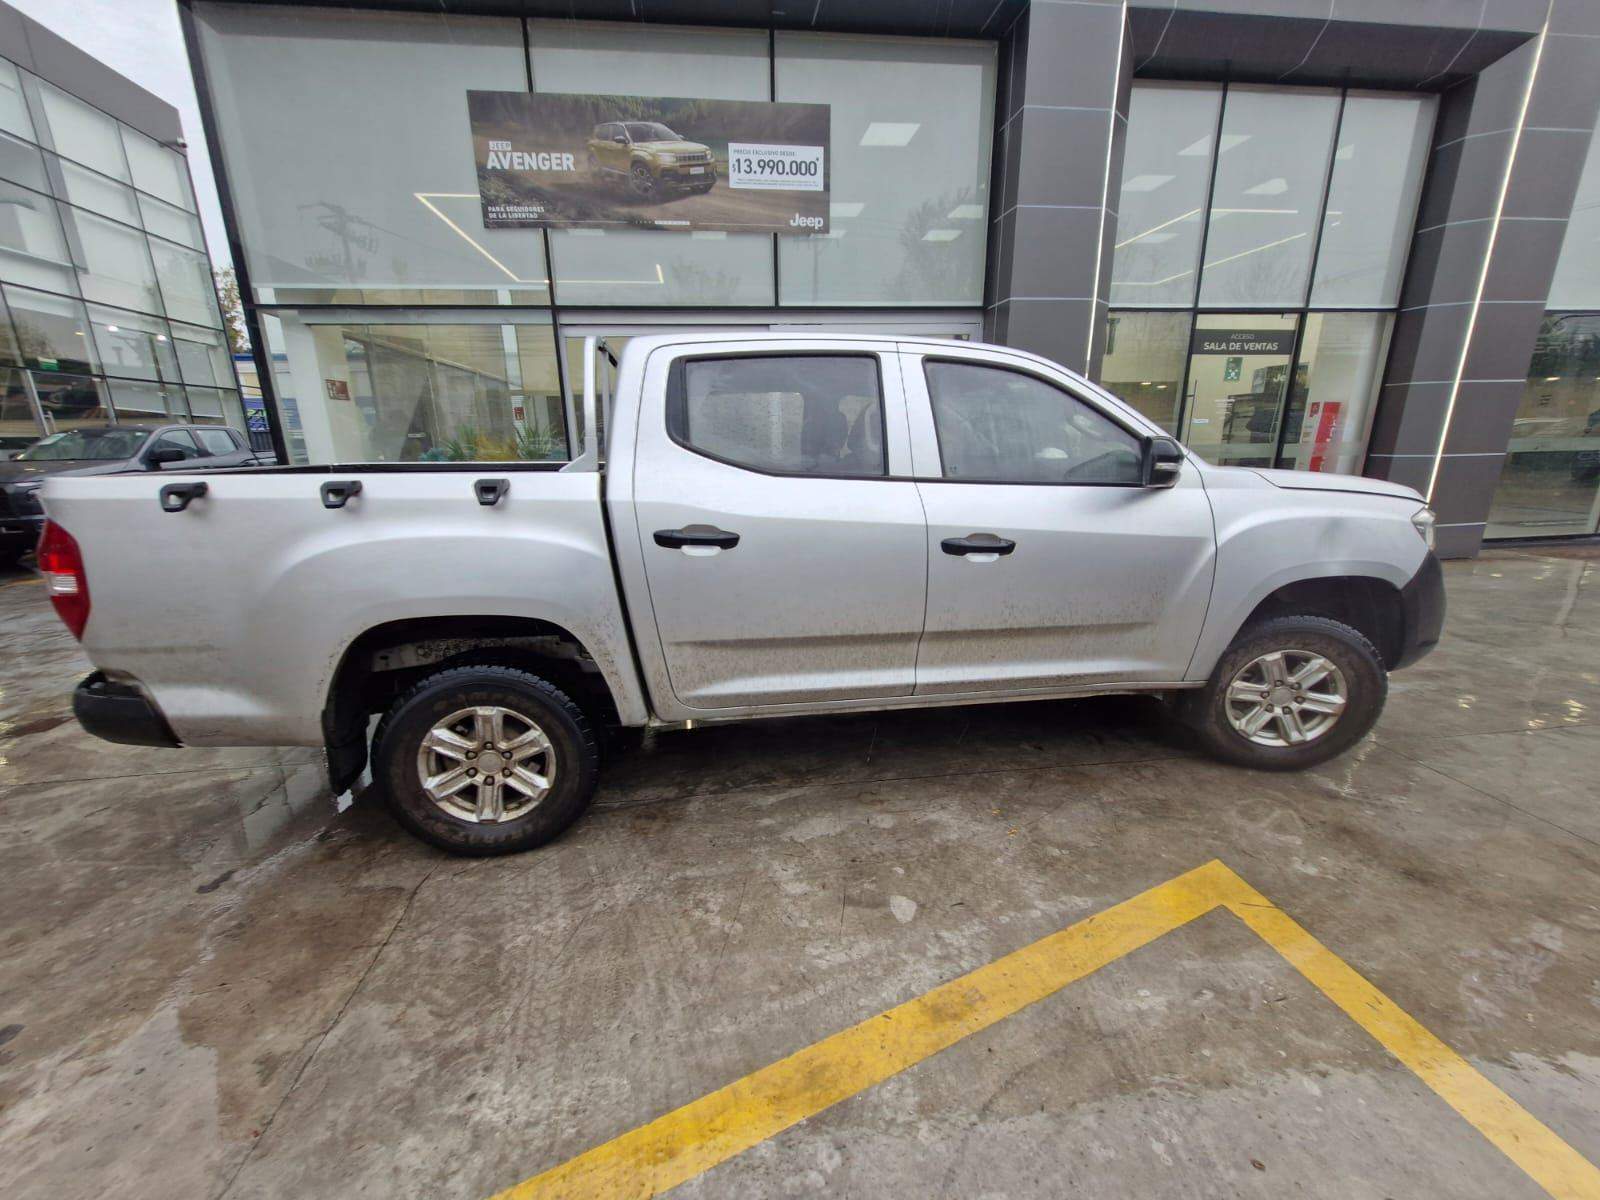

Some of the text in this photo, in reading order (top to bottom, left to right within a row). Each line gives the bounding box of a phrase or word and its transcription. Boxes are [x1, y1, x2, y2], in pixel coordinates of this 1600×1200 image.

[491, 141, 511, 151] JEEP
[486, 151, 576, 171] AVENGER
[790, 212, 824, 230] Jeep
[1203, 342, 1279, 351] SALA DE VENTAS
